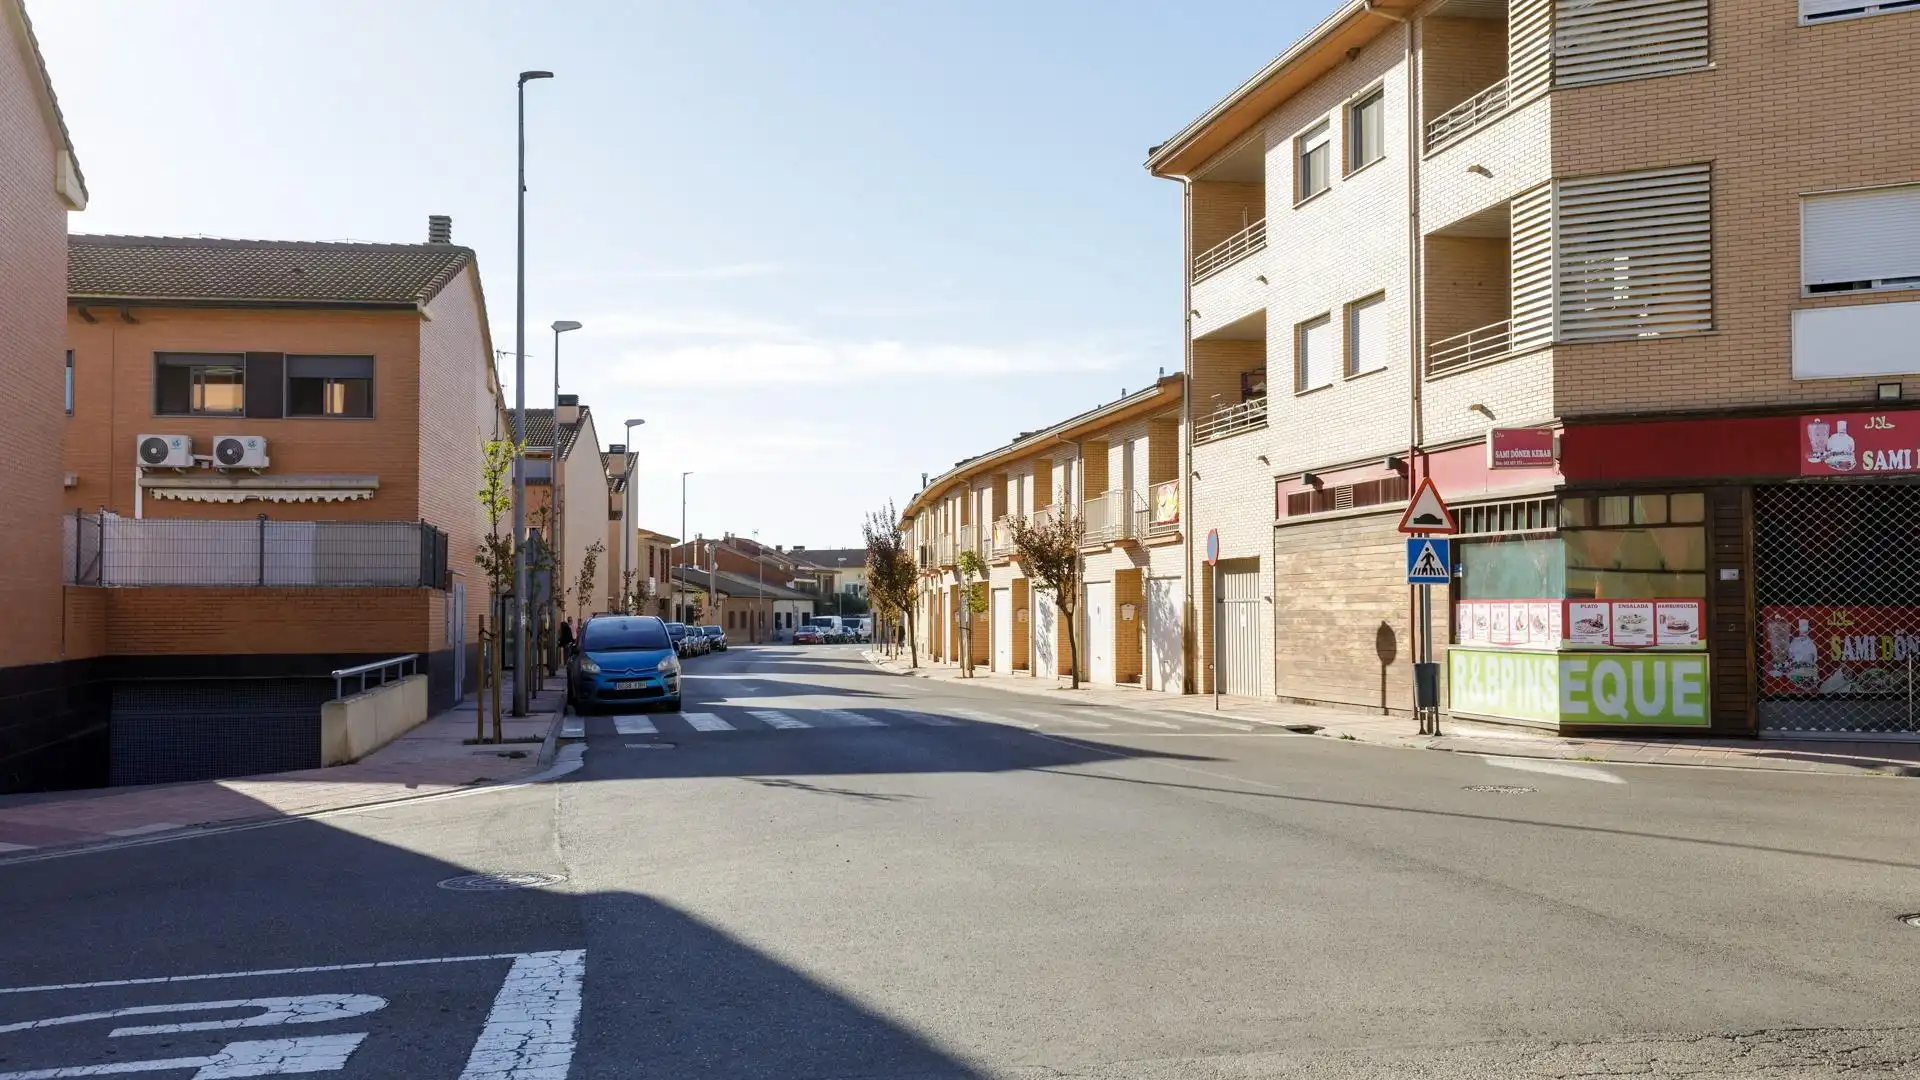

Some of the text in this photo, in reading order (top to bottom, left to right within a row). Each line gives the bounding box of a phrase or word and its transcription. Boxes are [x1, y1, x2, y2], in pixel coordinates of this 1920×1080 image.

[1495, 450, 1510, 459] SAMI
[1510, 448, 1531, 458] DÖNER
[1862, 449, 1912, 471] SAMI
[1830, 635, 1877, 661] SAMI
